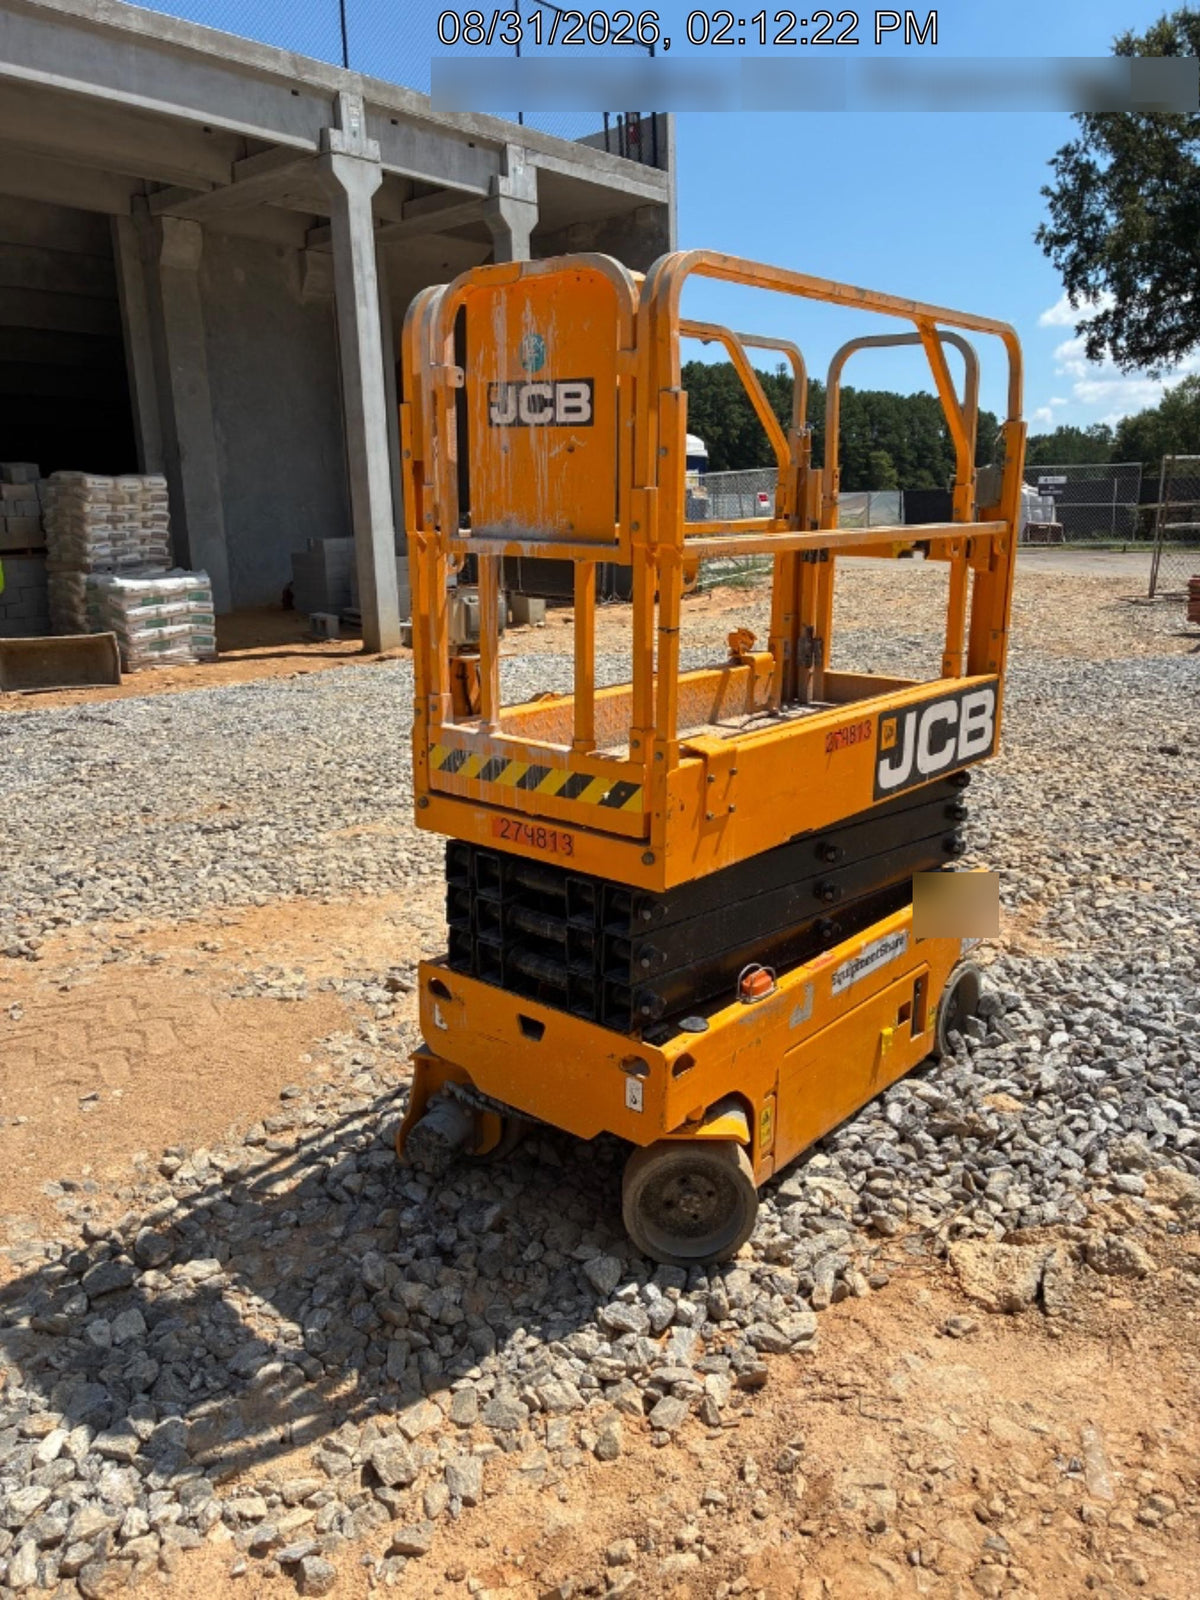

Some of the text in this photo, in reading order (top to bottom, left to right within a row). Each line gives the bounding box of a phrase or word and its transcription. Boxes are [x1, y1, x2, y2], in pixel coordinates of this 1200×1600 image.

[490, 383, 591, 424] JCB
[878, 689, 995, 789] JCB
[500, 818, 575, 856] 274813
[832, 936, 904, 986] EquipmentShare
